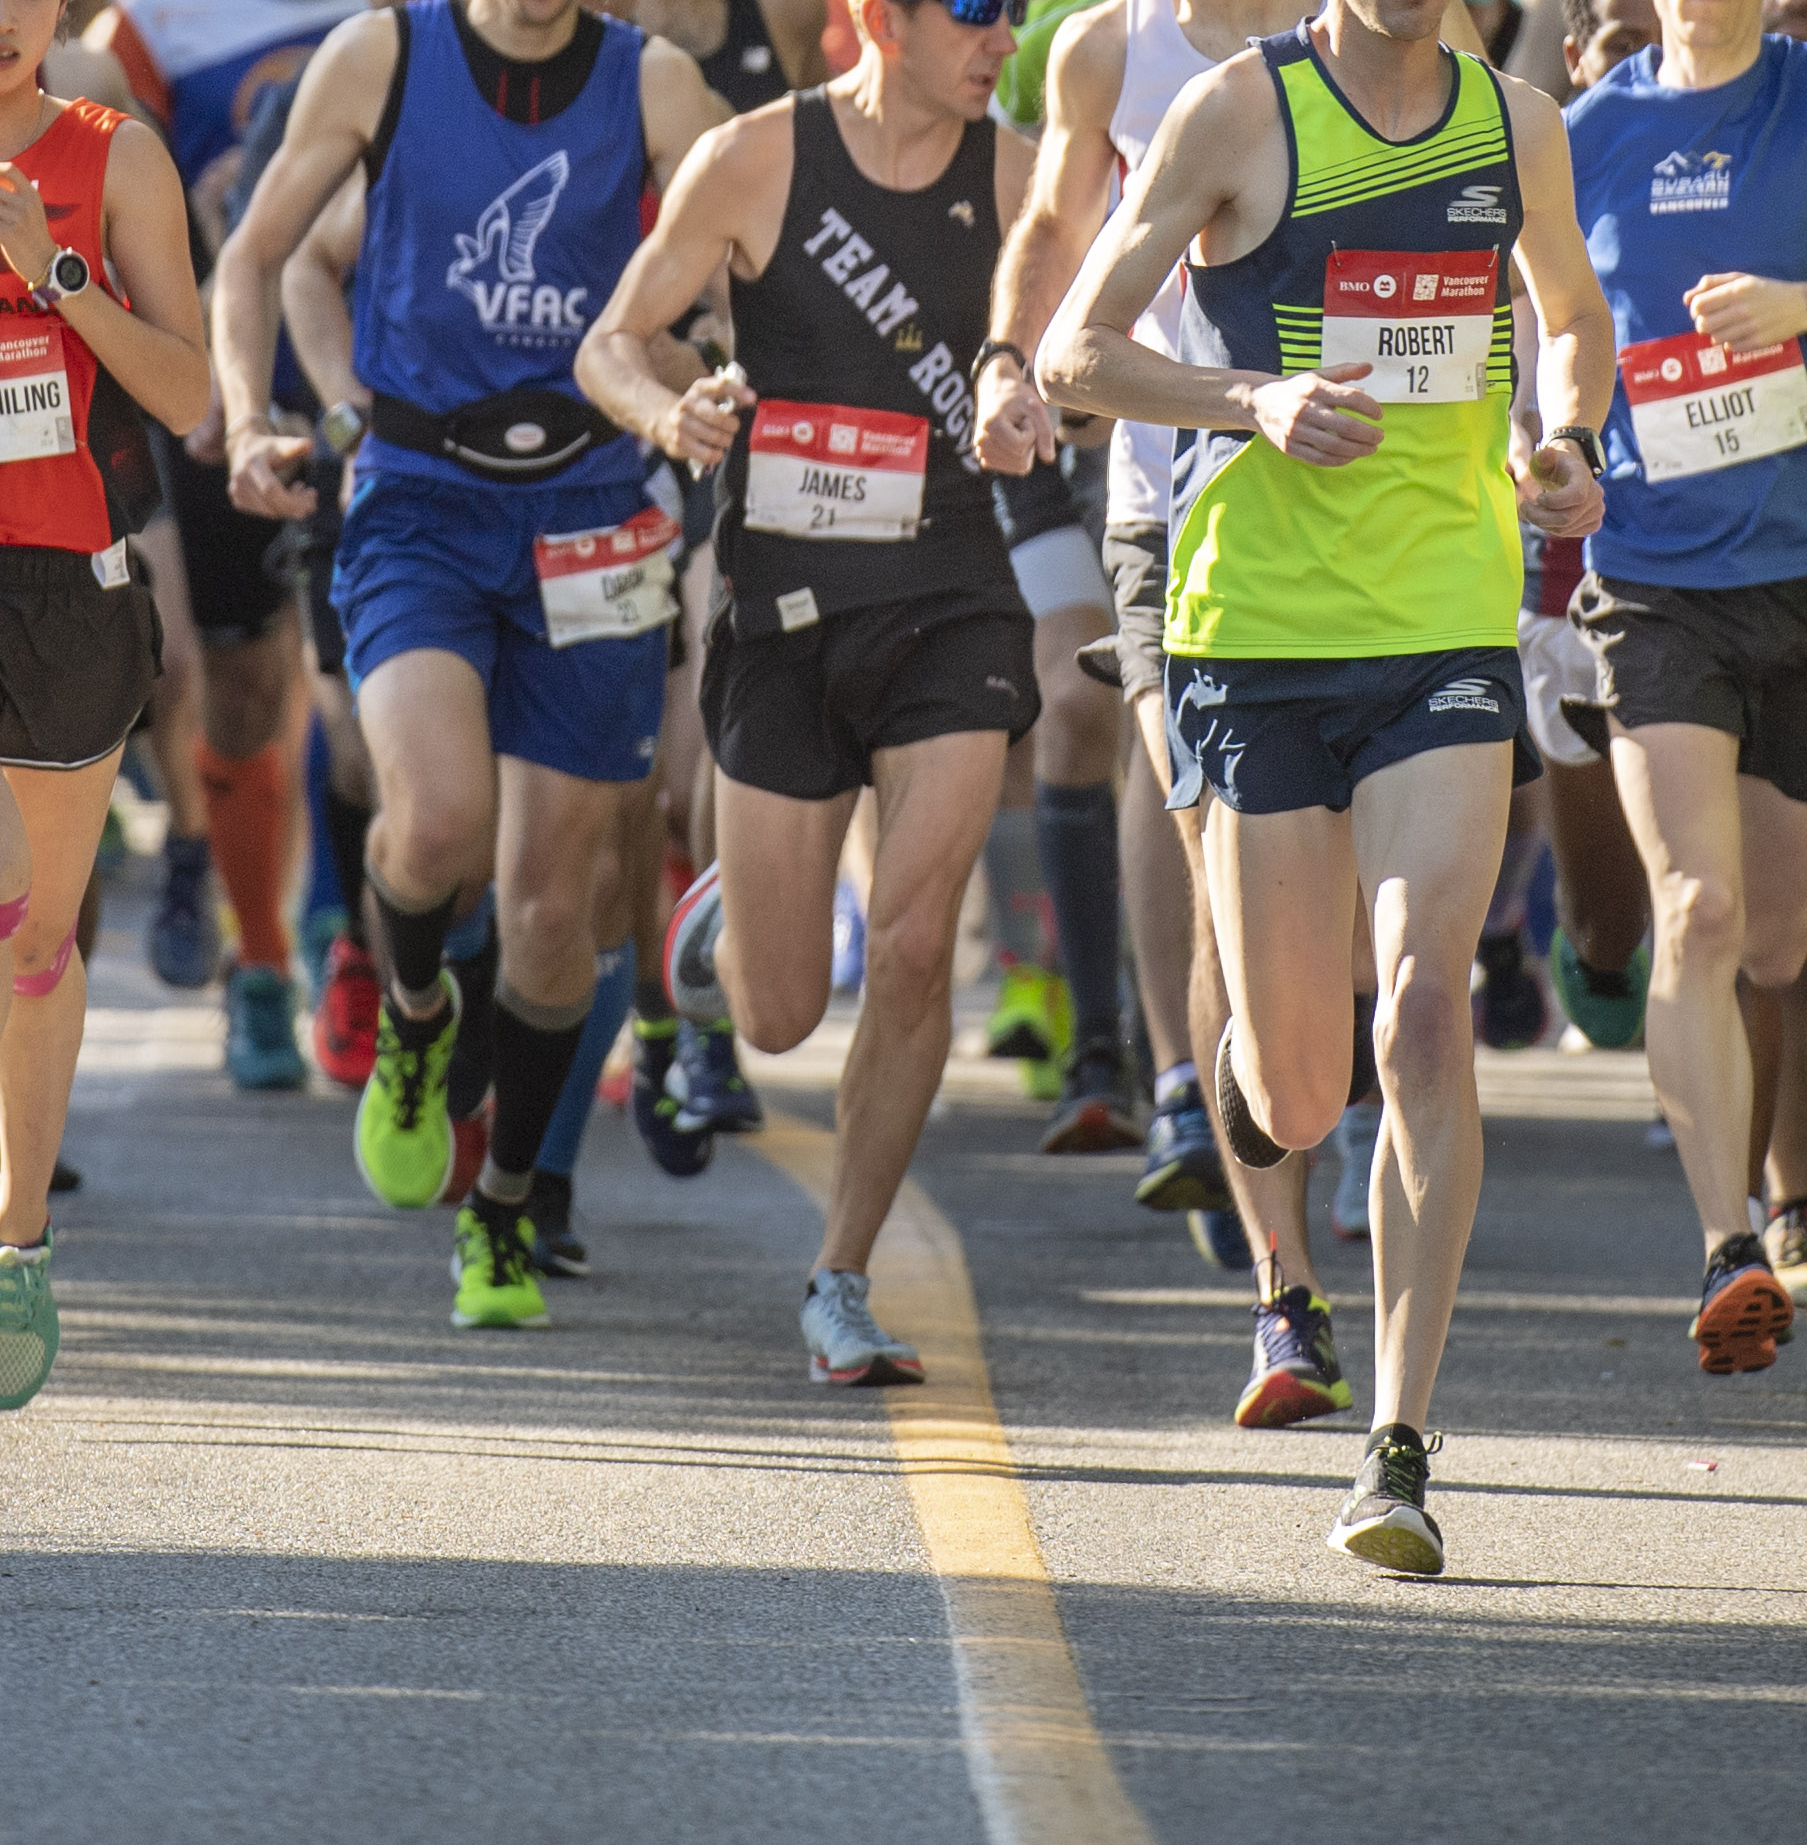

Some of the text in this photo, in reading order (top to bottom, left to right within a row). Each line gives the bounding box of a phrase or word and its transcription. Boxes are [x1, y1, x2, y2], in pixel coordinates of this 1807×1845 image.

[1446, 207, 1507, 217] SKECHERS
[803, 206, 920, 338] TEAM
[1339, 280, 1370, 292] BMO
[1443, 275, 1489, 286] Vancouver
[473, 279, 589, 328] VFAC
[1441, 286, 1485, 297] Marathon
[1378, 325, 1455, 356] ROBERT
[1406, 365, 1429, 394] 12
[1685, 387, 1755, 429] ELLIOT
[1714, 428, 1740, 456] 15
[799, 467, 867, 501] JAMES
[1428, 696, 1498, 708] SKECHERS
